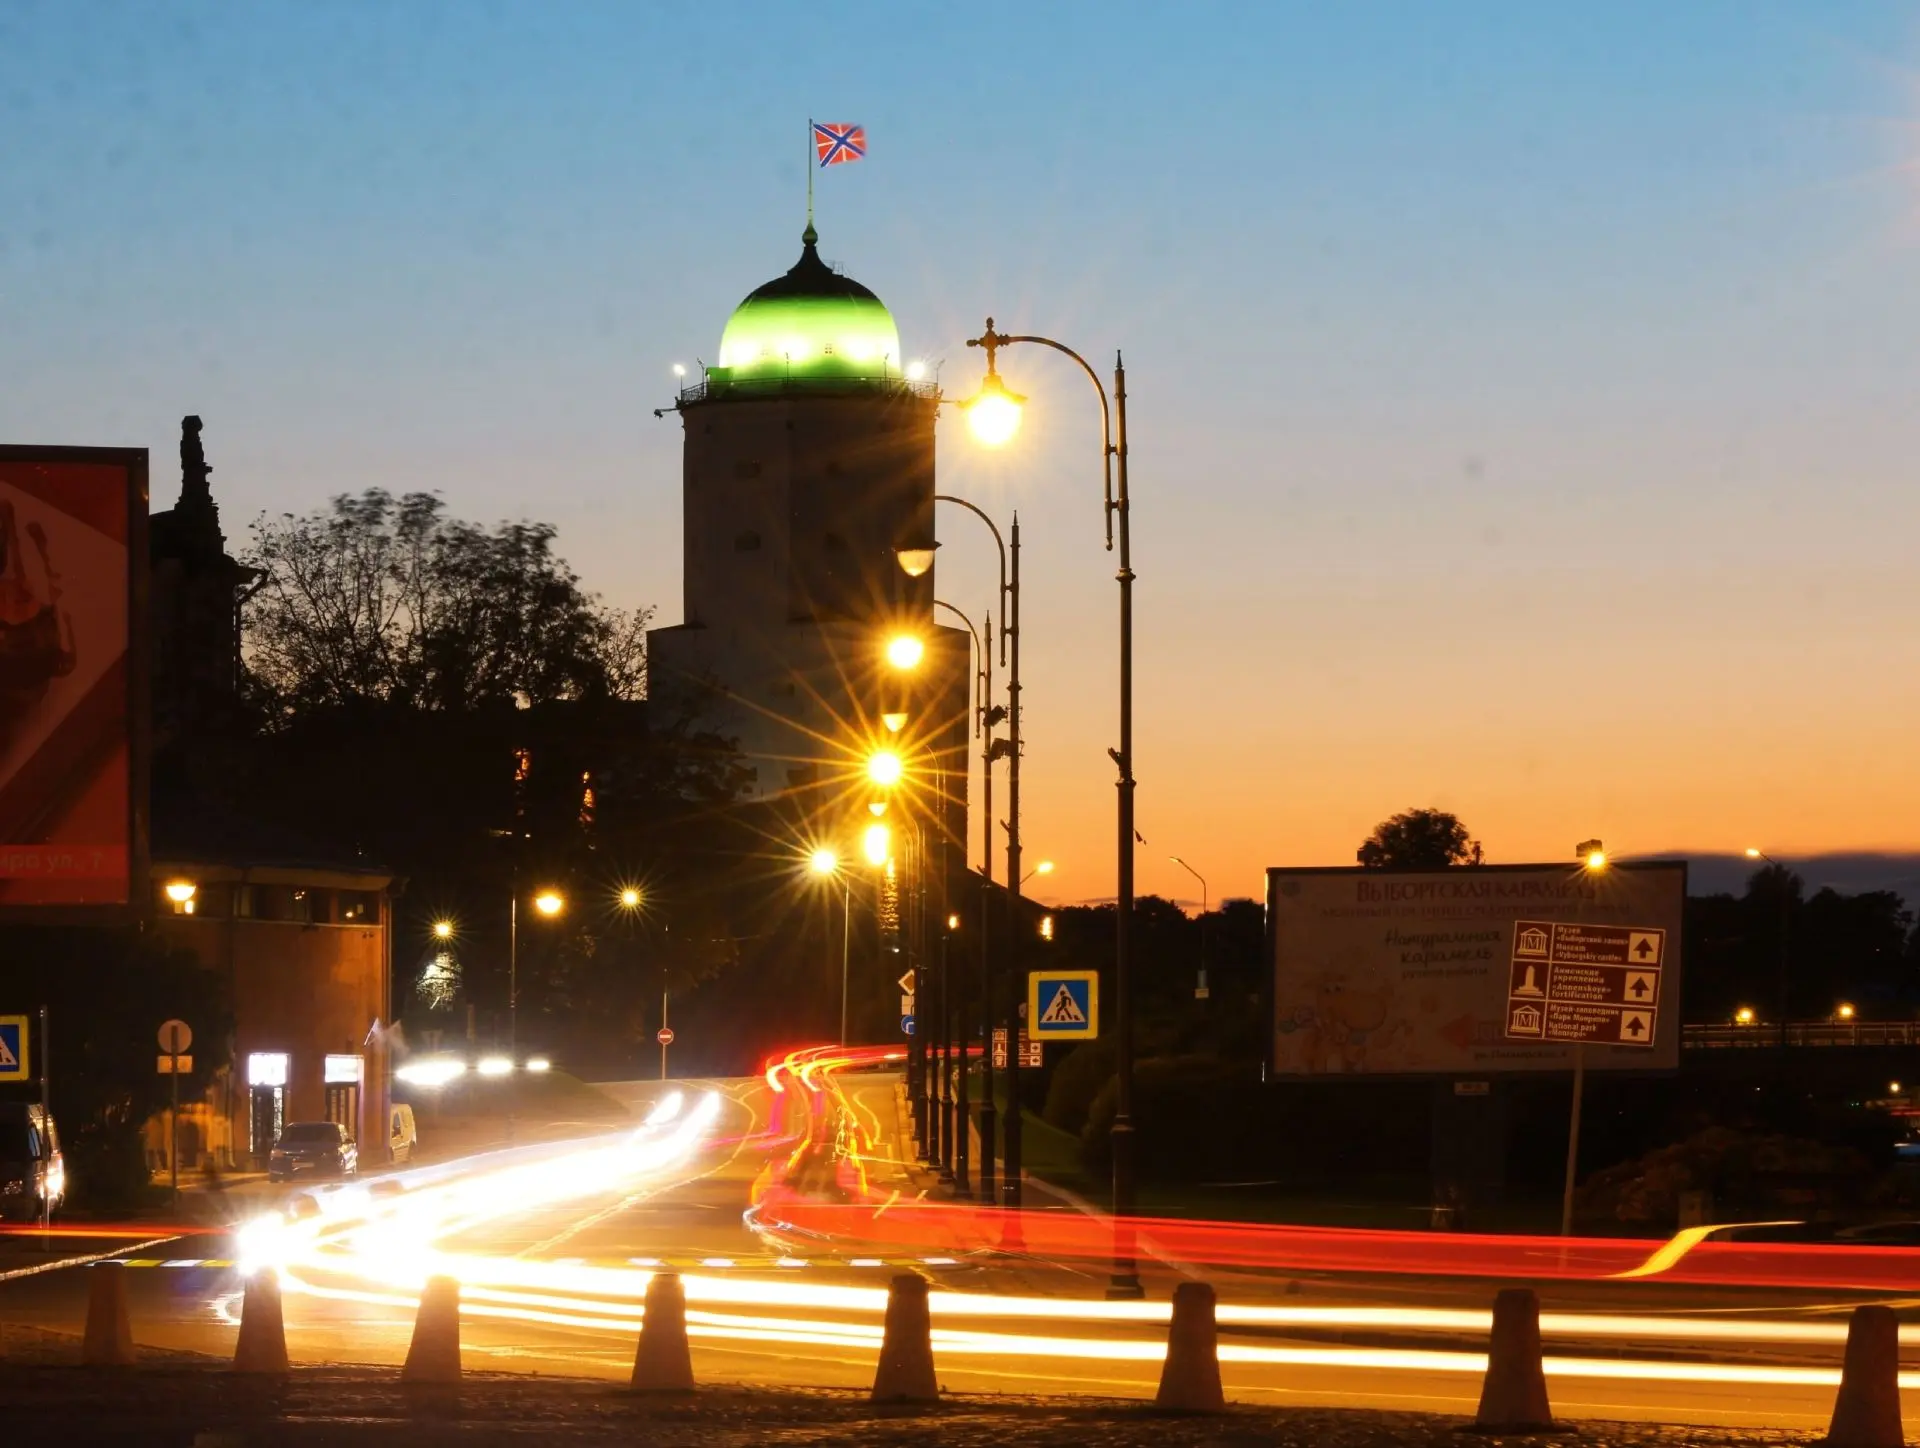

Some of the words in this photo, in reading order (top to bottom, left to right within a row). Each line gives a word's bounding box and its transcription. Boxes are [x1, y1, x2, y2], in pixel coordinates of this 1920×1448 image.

[1356, 879, 1491, 902] ВЫБОРГСКАЯ
[1557, 926, 1582, 935] Музей
[1552, 989, 1603, 1001] fortification
[1548, 1021, 1579, 1031] National
[1580, 1023, 1597, 1032] park
